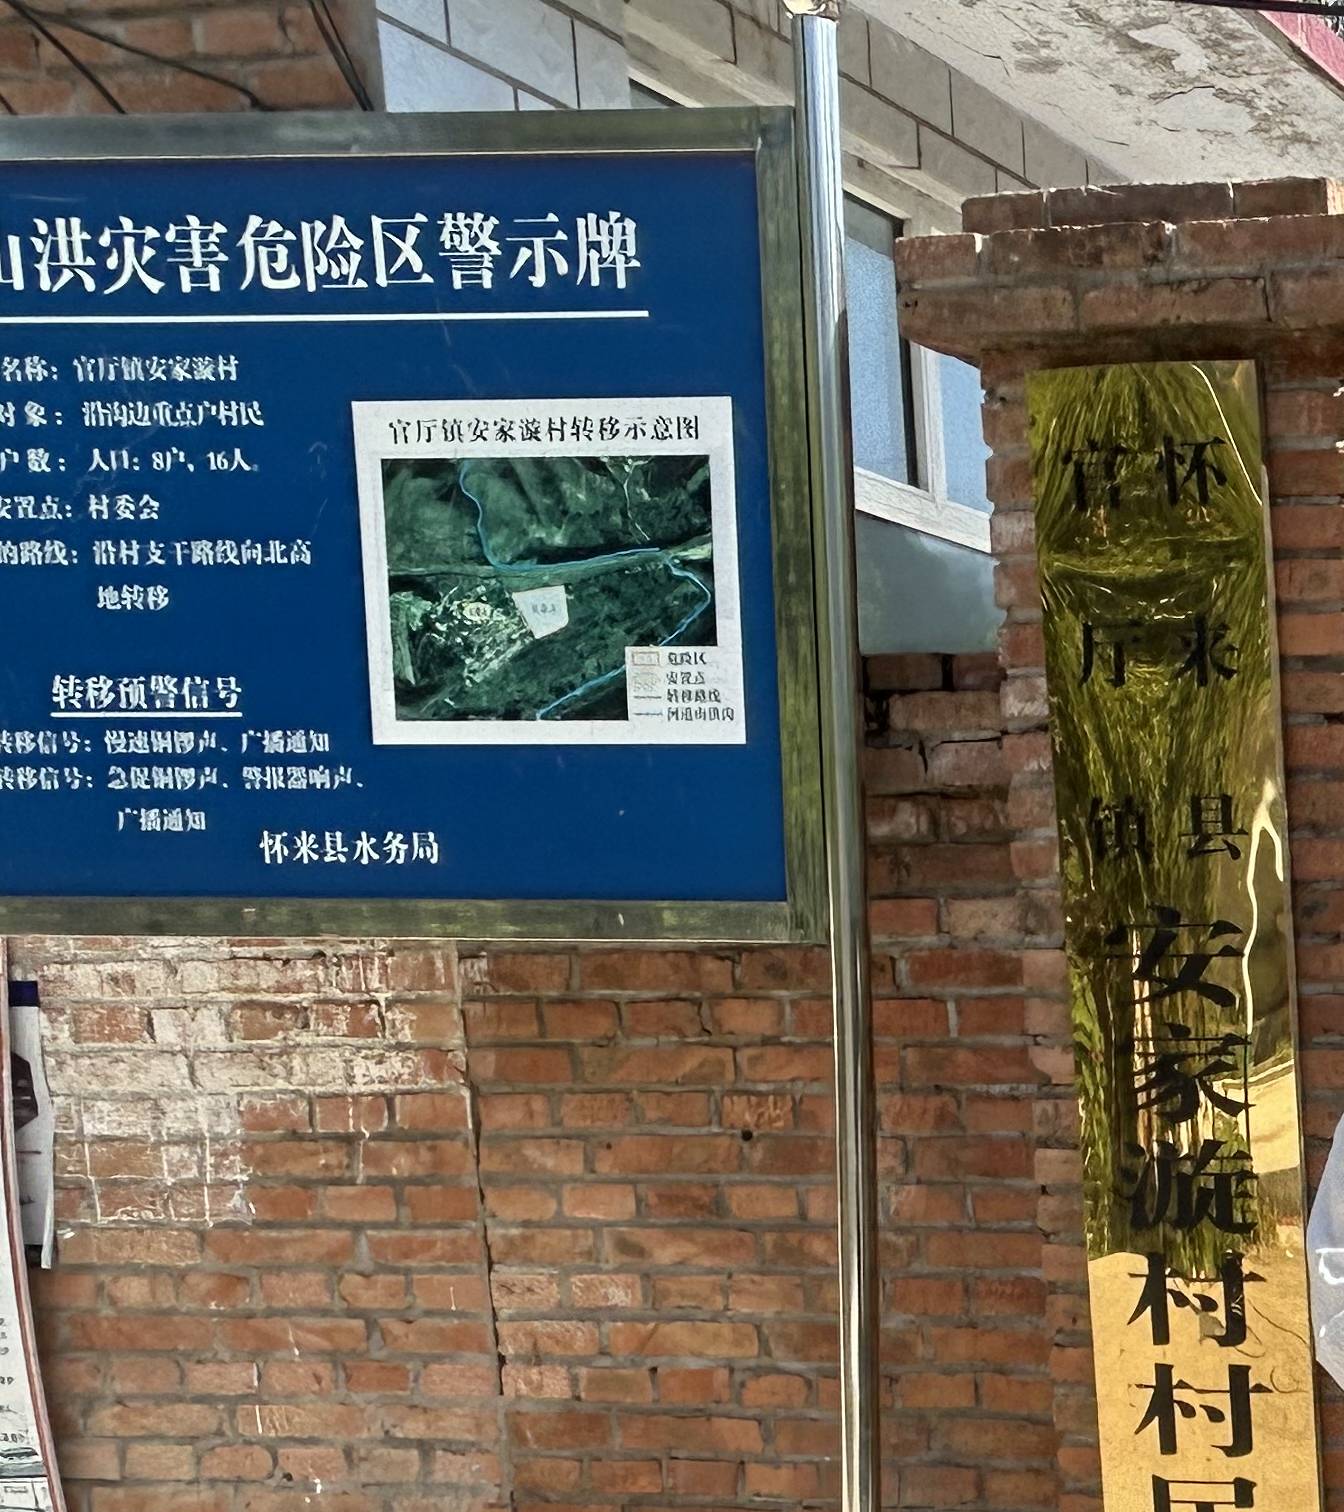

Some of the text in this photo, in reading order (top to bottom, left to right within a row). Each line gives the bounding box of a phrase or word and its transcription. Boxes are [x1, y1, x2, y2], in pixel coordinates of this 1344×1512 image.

[97, 584, 169, 611] 地转移
[1157, 436, 1249, 861] 怀来县
[51, 674, 242, 709] 转移预警信号
[118, 808, 206, 832] 广播通知
[259, 830, 439, 865] 怀来县水务局
